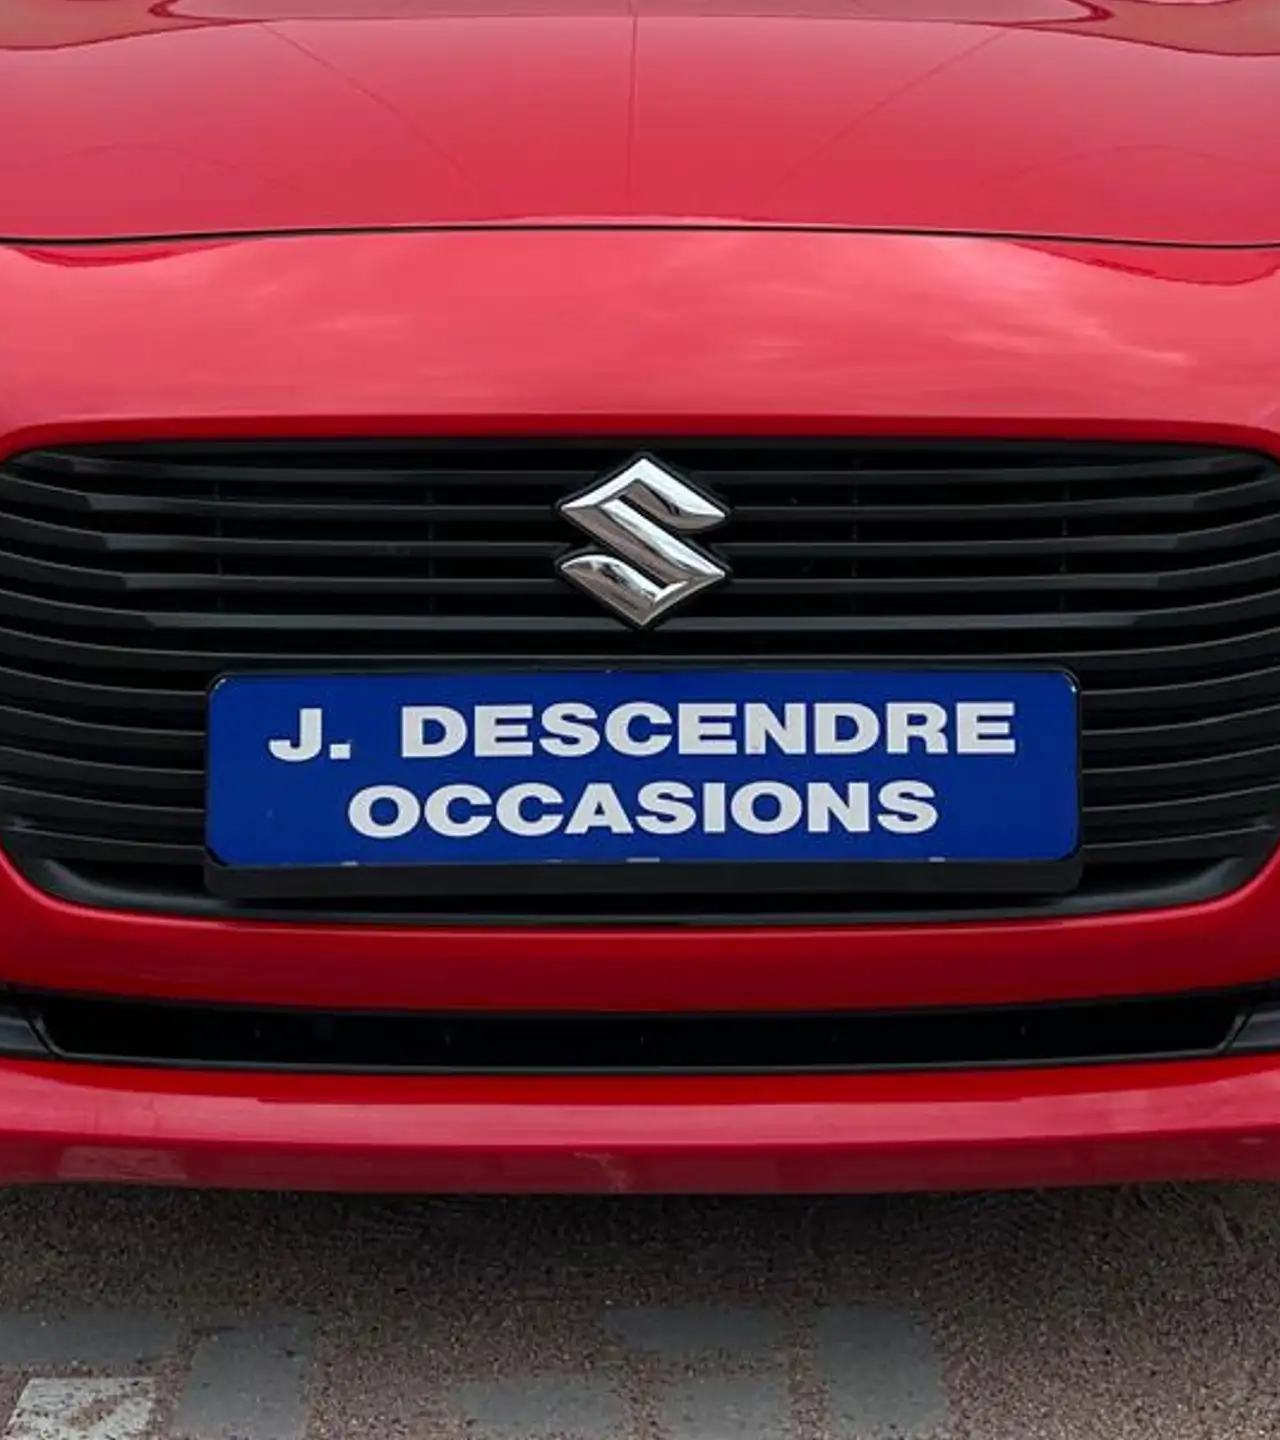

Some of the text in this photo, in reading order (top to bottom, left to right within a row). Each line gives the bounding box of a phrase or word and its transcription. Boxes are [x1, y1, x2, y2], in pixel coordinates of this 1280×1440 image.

[269, 701, 1016, 761] J. DESCENDRE
[348, 780, 938, 838] OCCASIONS
